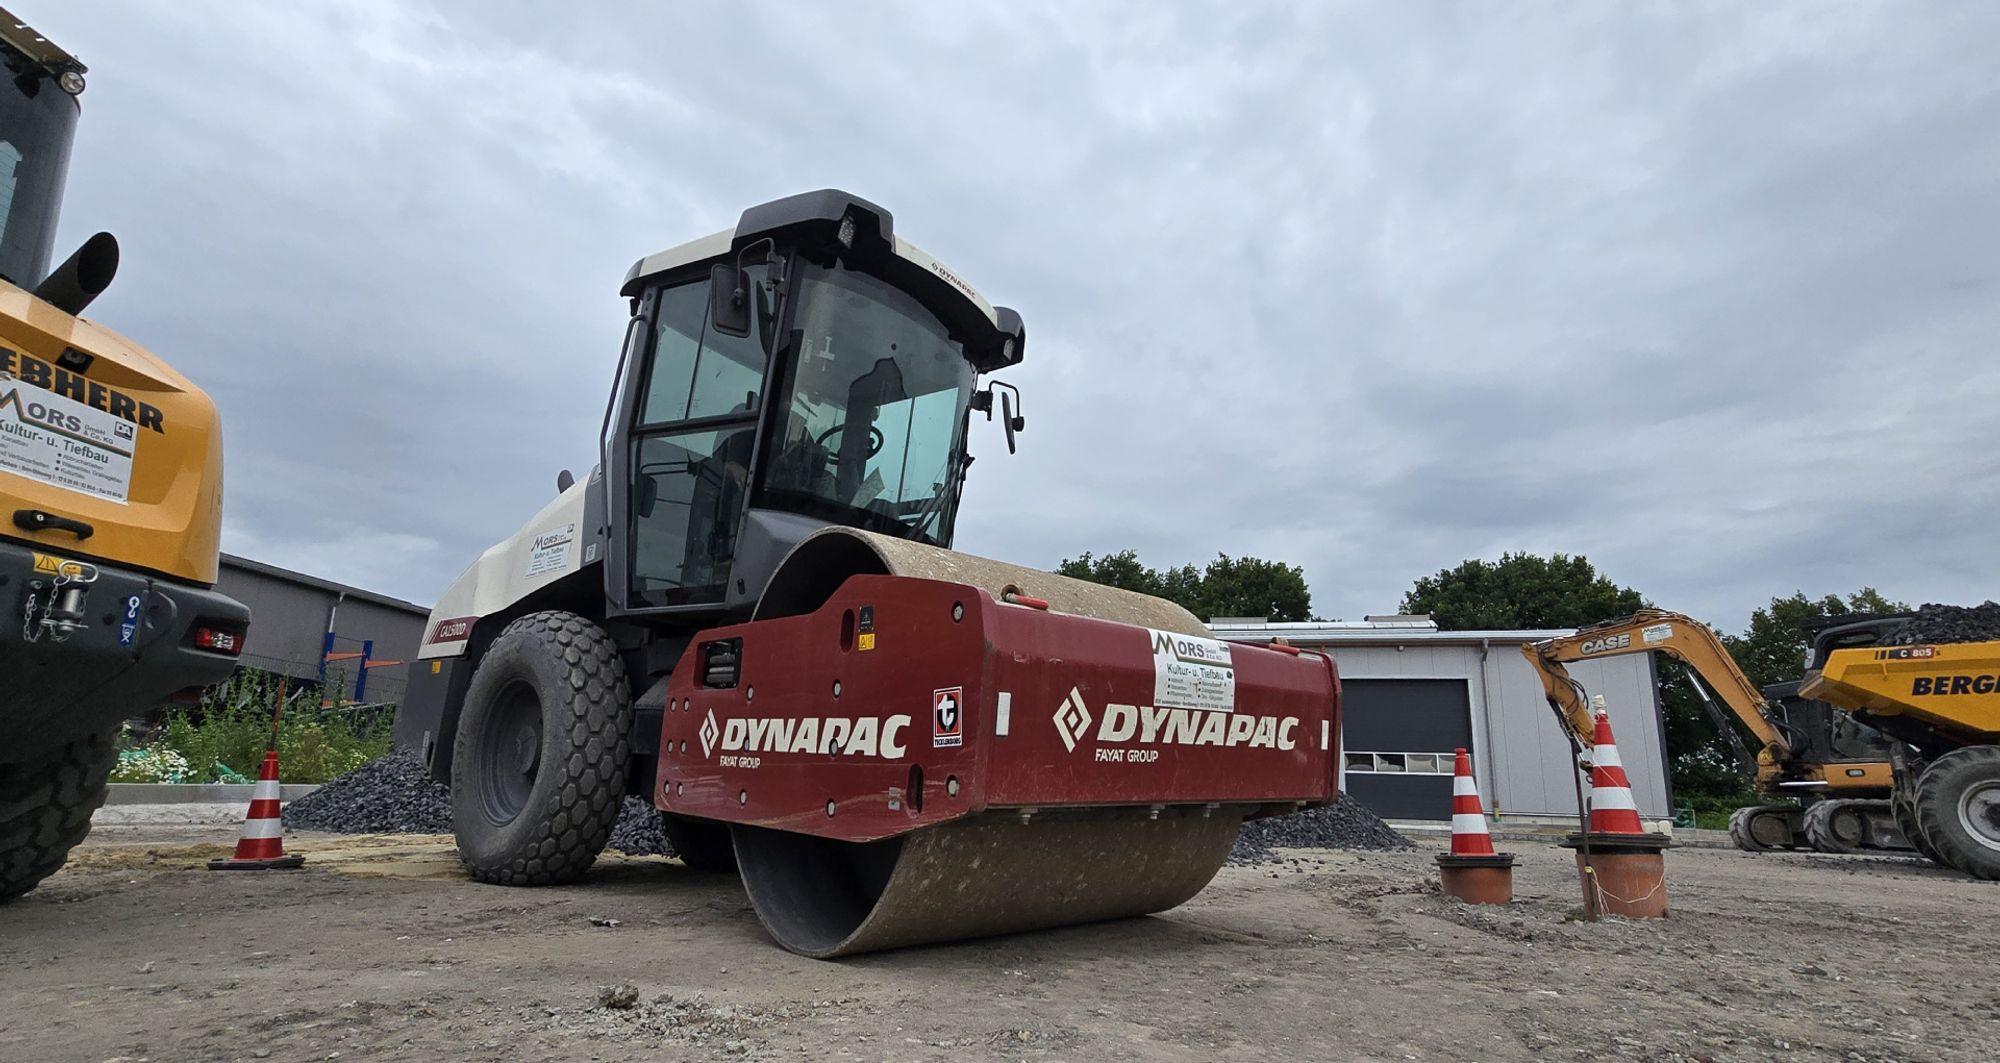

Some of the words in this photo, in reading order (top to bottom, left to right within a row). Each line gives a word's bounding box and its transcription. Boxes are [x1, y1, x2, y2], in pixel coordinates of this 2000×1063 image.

[939, 267, 976, 299] DYNAPAC
[46, 436, 59, 448] u.
[63, 439, 109, 463] Tiefbau
[1153, 631, 1205, 661] MORS
[1581, 634, 1631, 655] CASE
[1912, 648, 1932, 657] 805
[1200, 667, 1224, 680] Tiefbau
[1912, 675, 2000, 696] BERG
[721, 714, 911, 759] DYNAPAC
[1096, 703, 1299, 751] DYNAPAC
[720, 756, 737, 767] FAYAT
[739, 757, 761, 768] GROUP
[1095, 748, 1124, 762] FAYAT
[1127, 750, 1159, 764] GROUP
